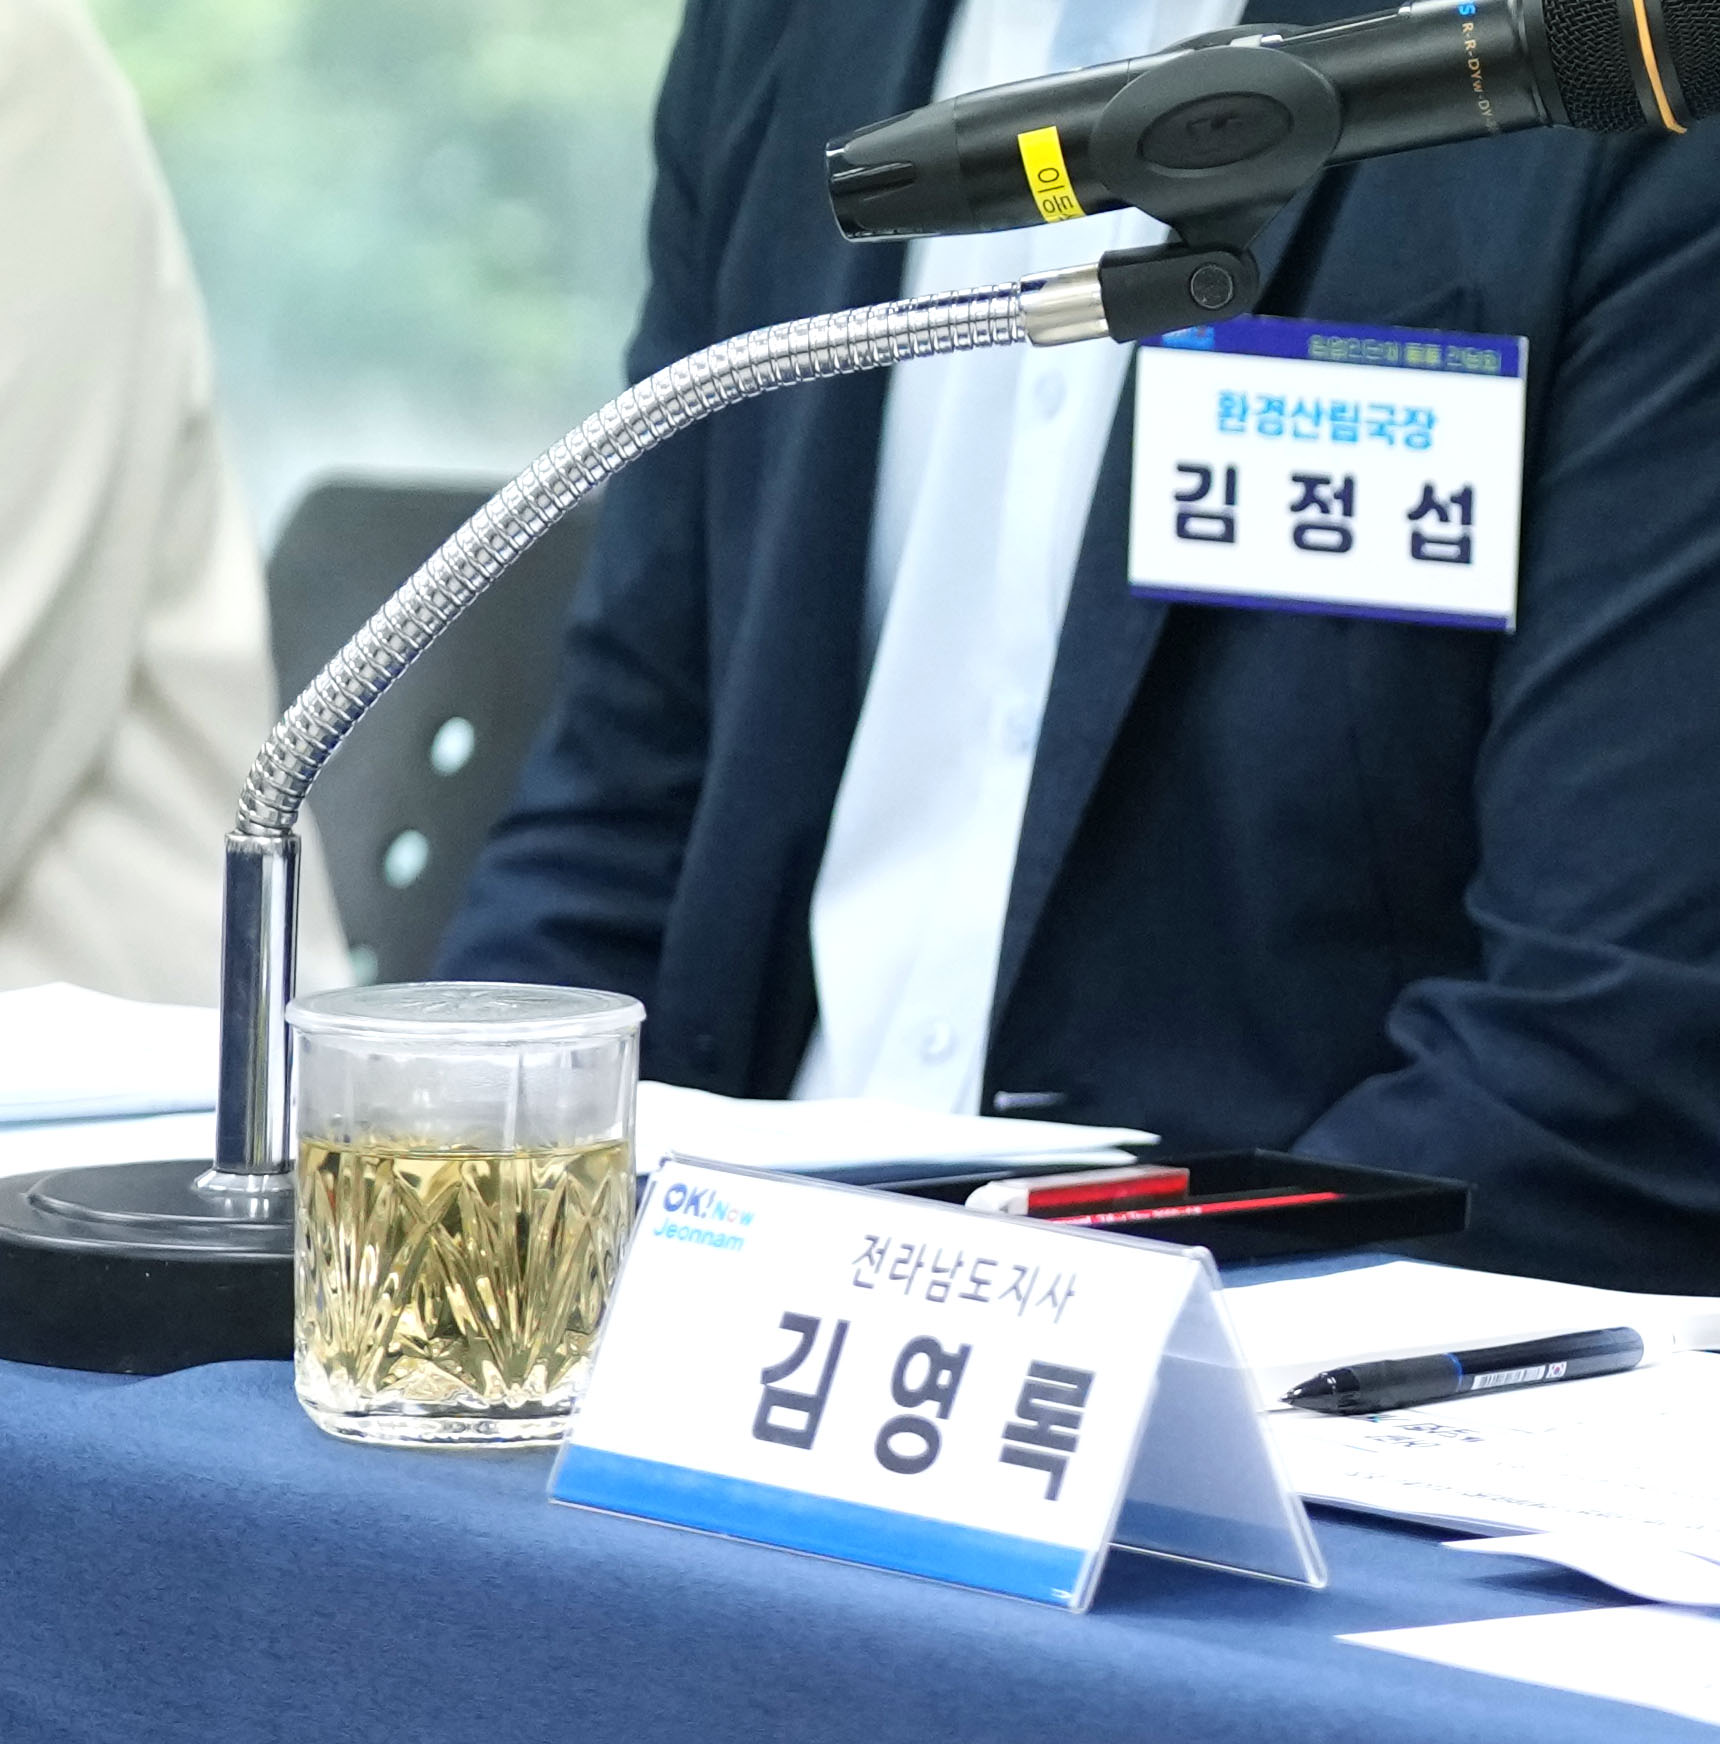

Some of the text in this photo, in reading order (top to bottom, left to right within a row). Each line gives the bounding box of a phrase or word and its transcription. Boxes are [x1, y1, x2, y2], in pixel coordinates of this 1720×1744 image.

[1216, 389, 1438, 452] 환경산림국장
[1174, 464, 1473, 565] 김정섭
[653, 1217, 745, 1252] Jeonnam
[850, 1233, 1077, 1325] 전라남도지사
[752, 1311, 1095, 1502] 김영록
